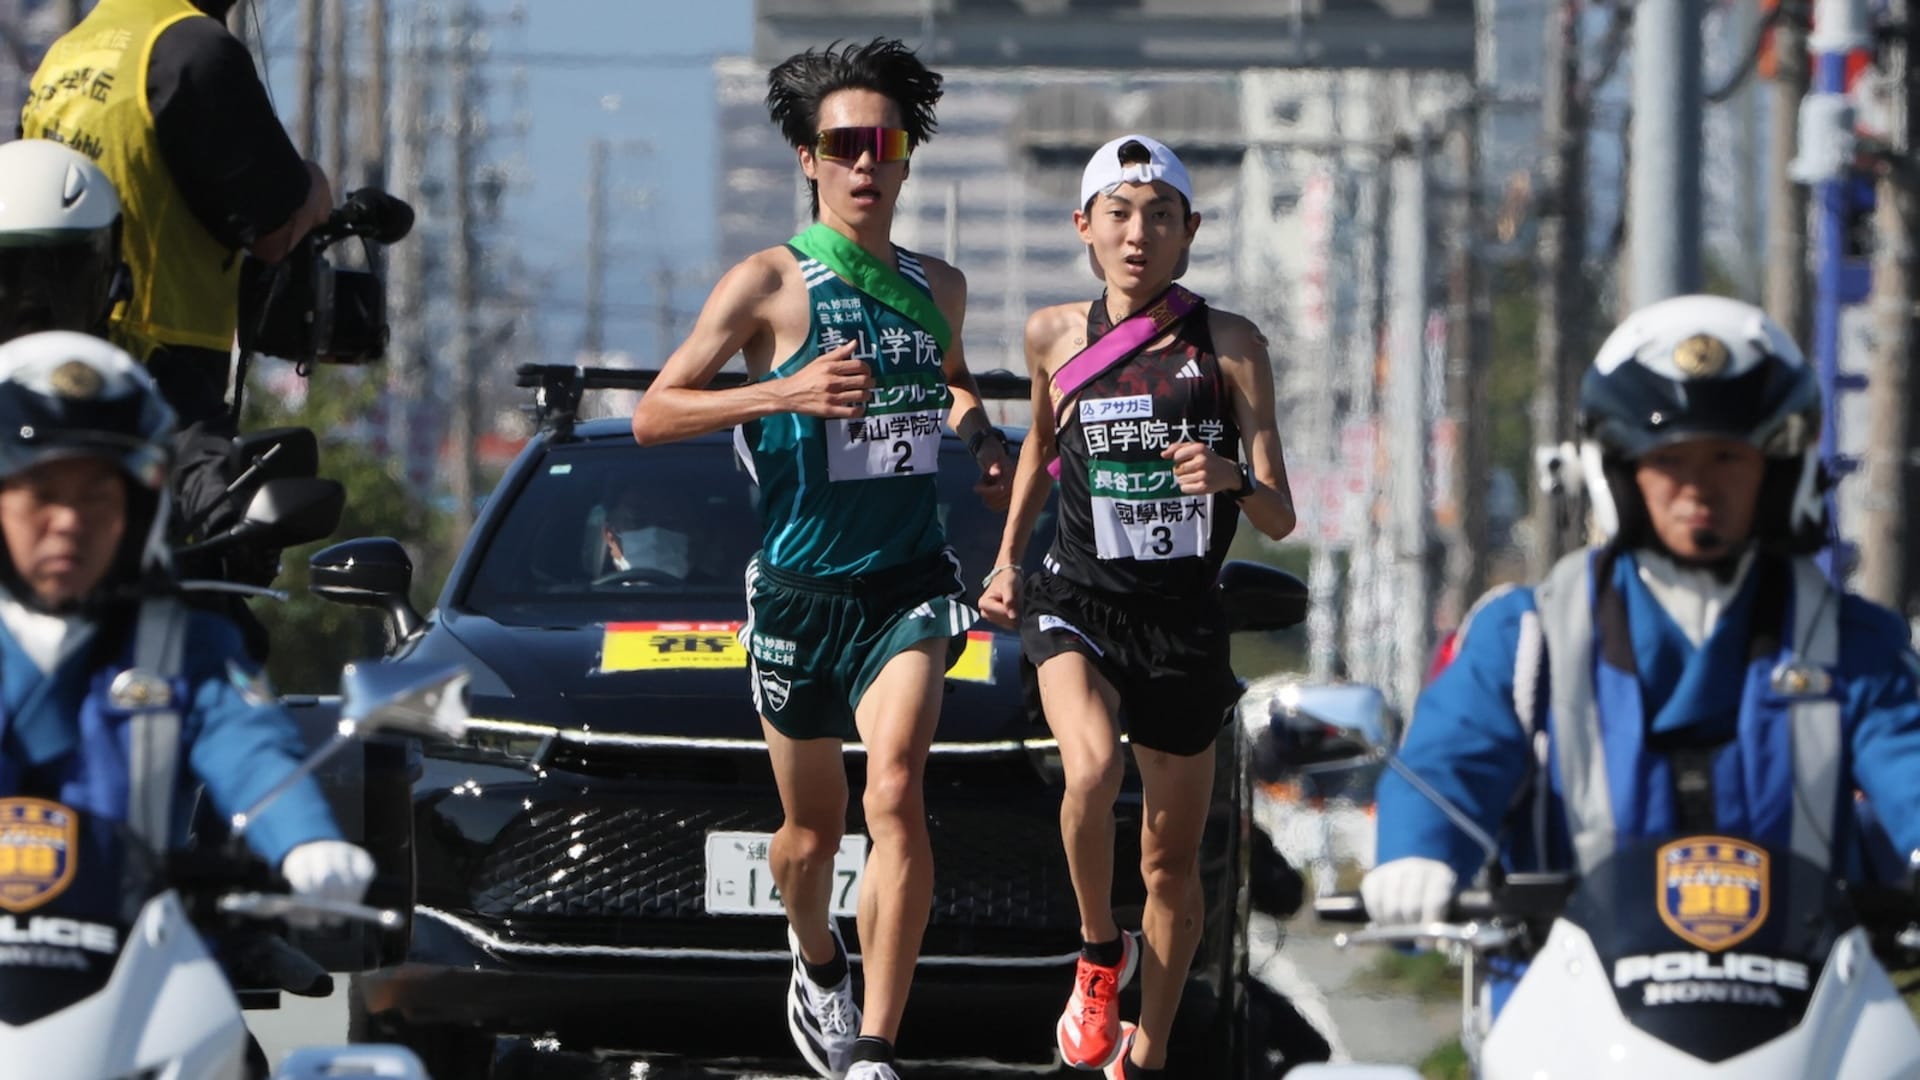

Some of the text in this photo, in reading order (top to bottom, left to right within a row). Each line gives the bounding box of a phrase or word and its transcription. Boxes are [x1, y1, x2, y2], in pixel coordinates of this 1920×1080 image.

[817, 326, 941, 367] 青山学院
[1100, 399, 1151, 415] アサガミ
[848, 413, 942, 444] 青山学院大
[1083, 418, 1224, 456] 国学院大学
[892, 440, 914, 472] 2
[1115, 499, 1206, 525] 國學院大
[1152, 526, 1173, 556] 3
[762, 649, 795, 667] 水上村
[1614, 951, 1809, 990] POLICE
[1643, 981, 1783, 1008] HONDA
